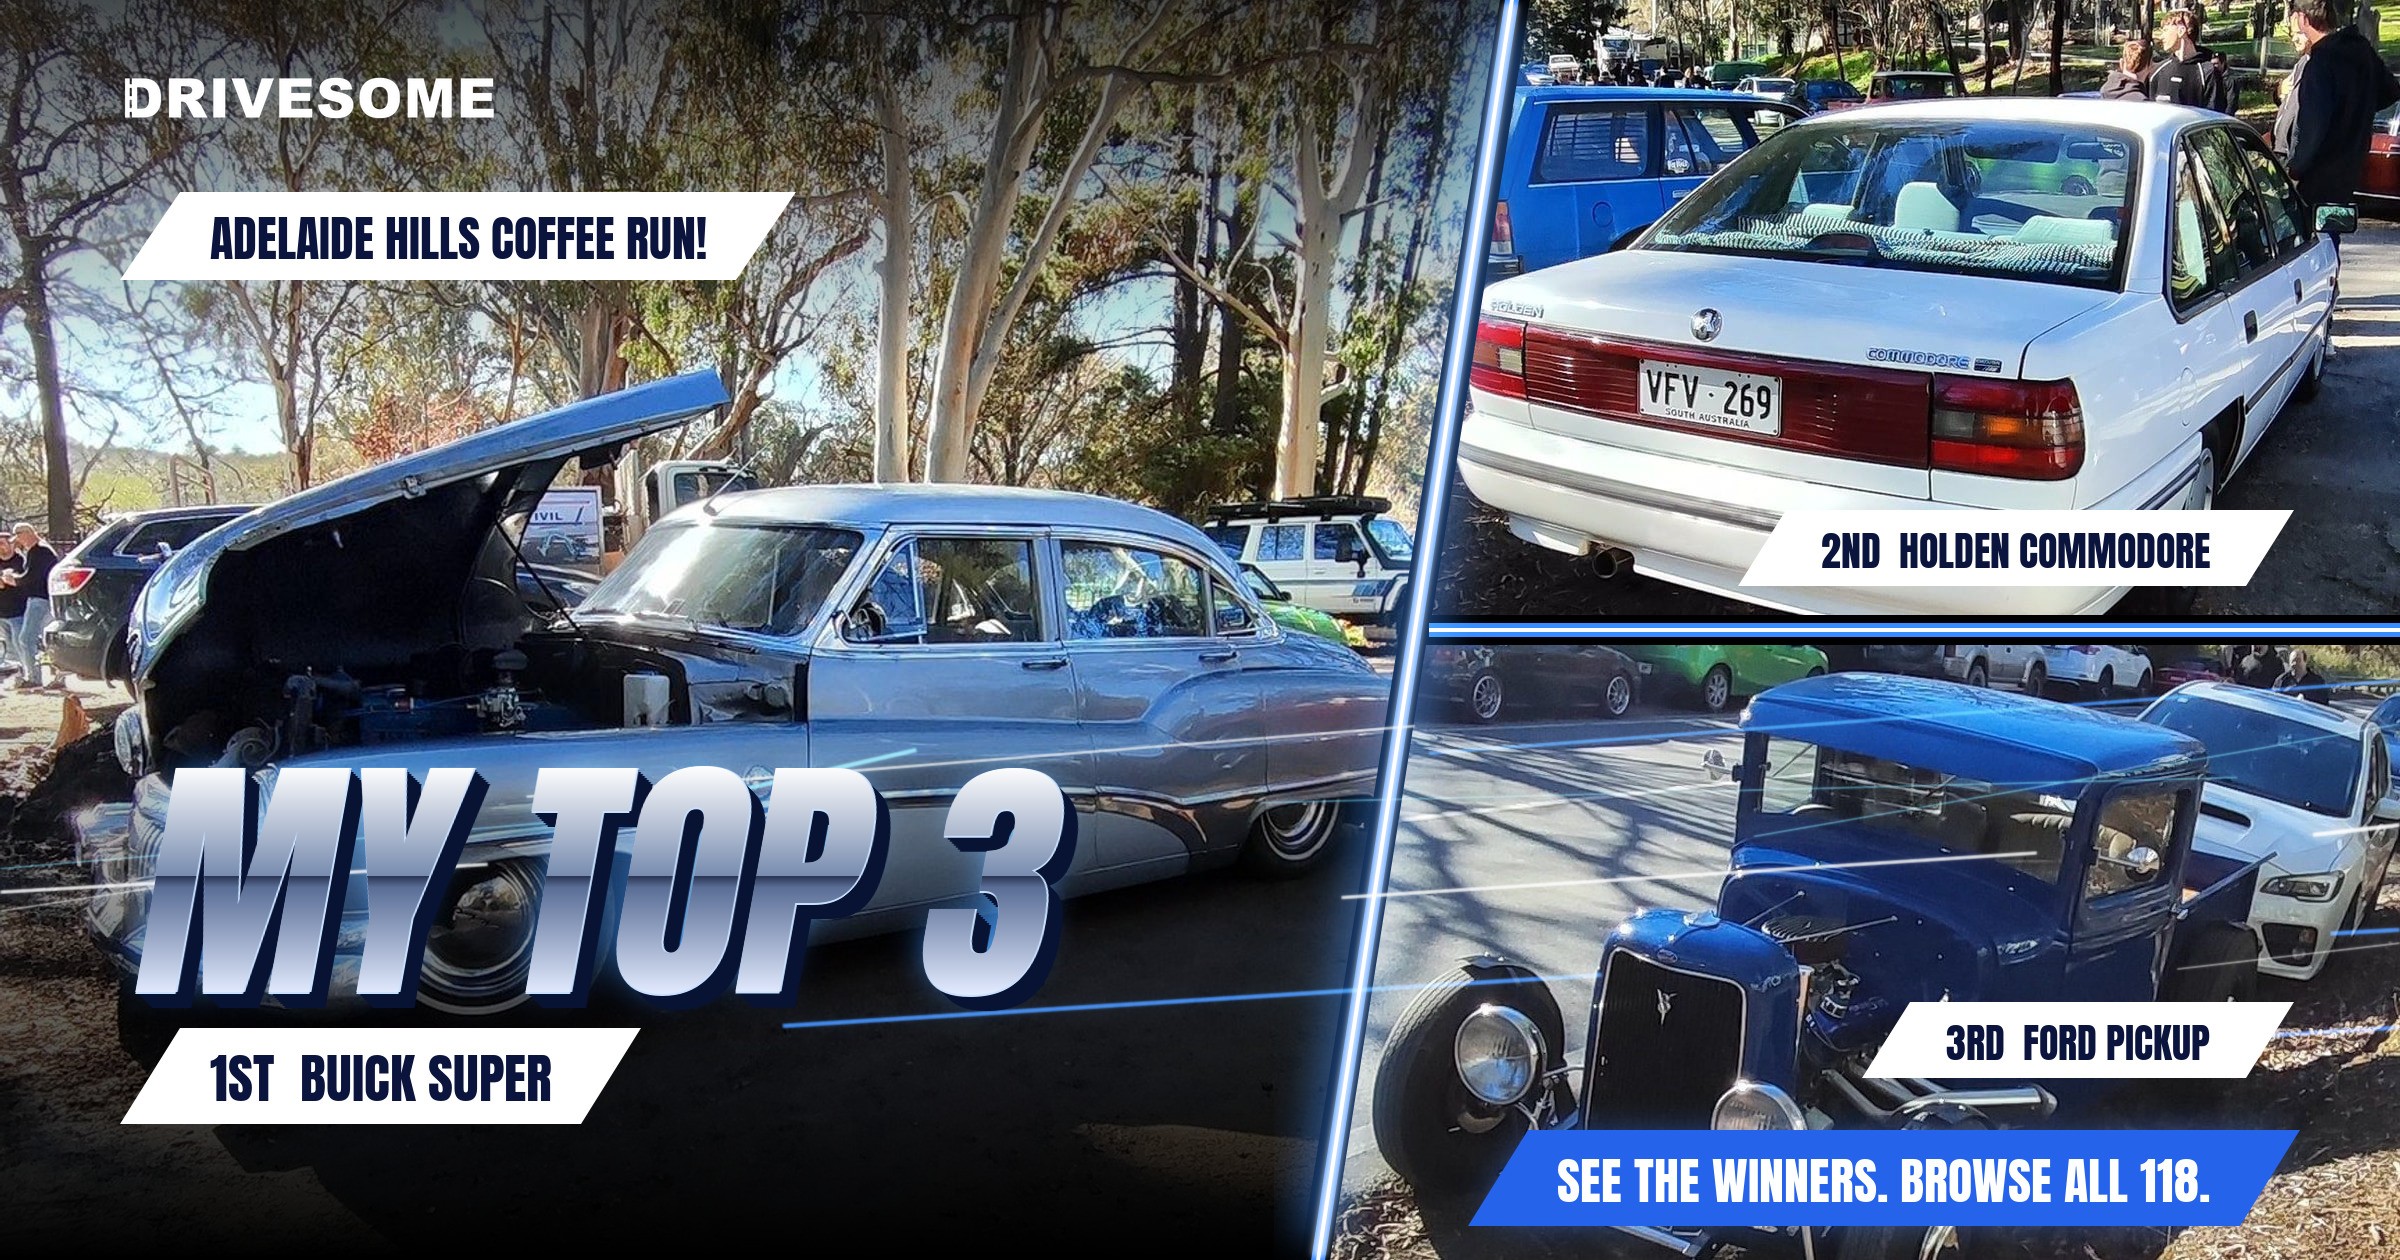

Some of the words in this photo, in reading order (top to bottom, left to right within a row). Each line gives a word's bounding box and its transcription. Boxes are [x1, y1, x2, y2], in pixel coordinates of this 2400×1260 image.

[1867, 347, 1969, 370] COMMODORE
[1665, 408, 1695, 420] SOUTH
[1699, 413, 1750, 429] AUSTRALIA
[534, 512, 563, 521] IVIL
